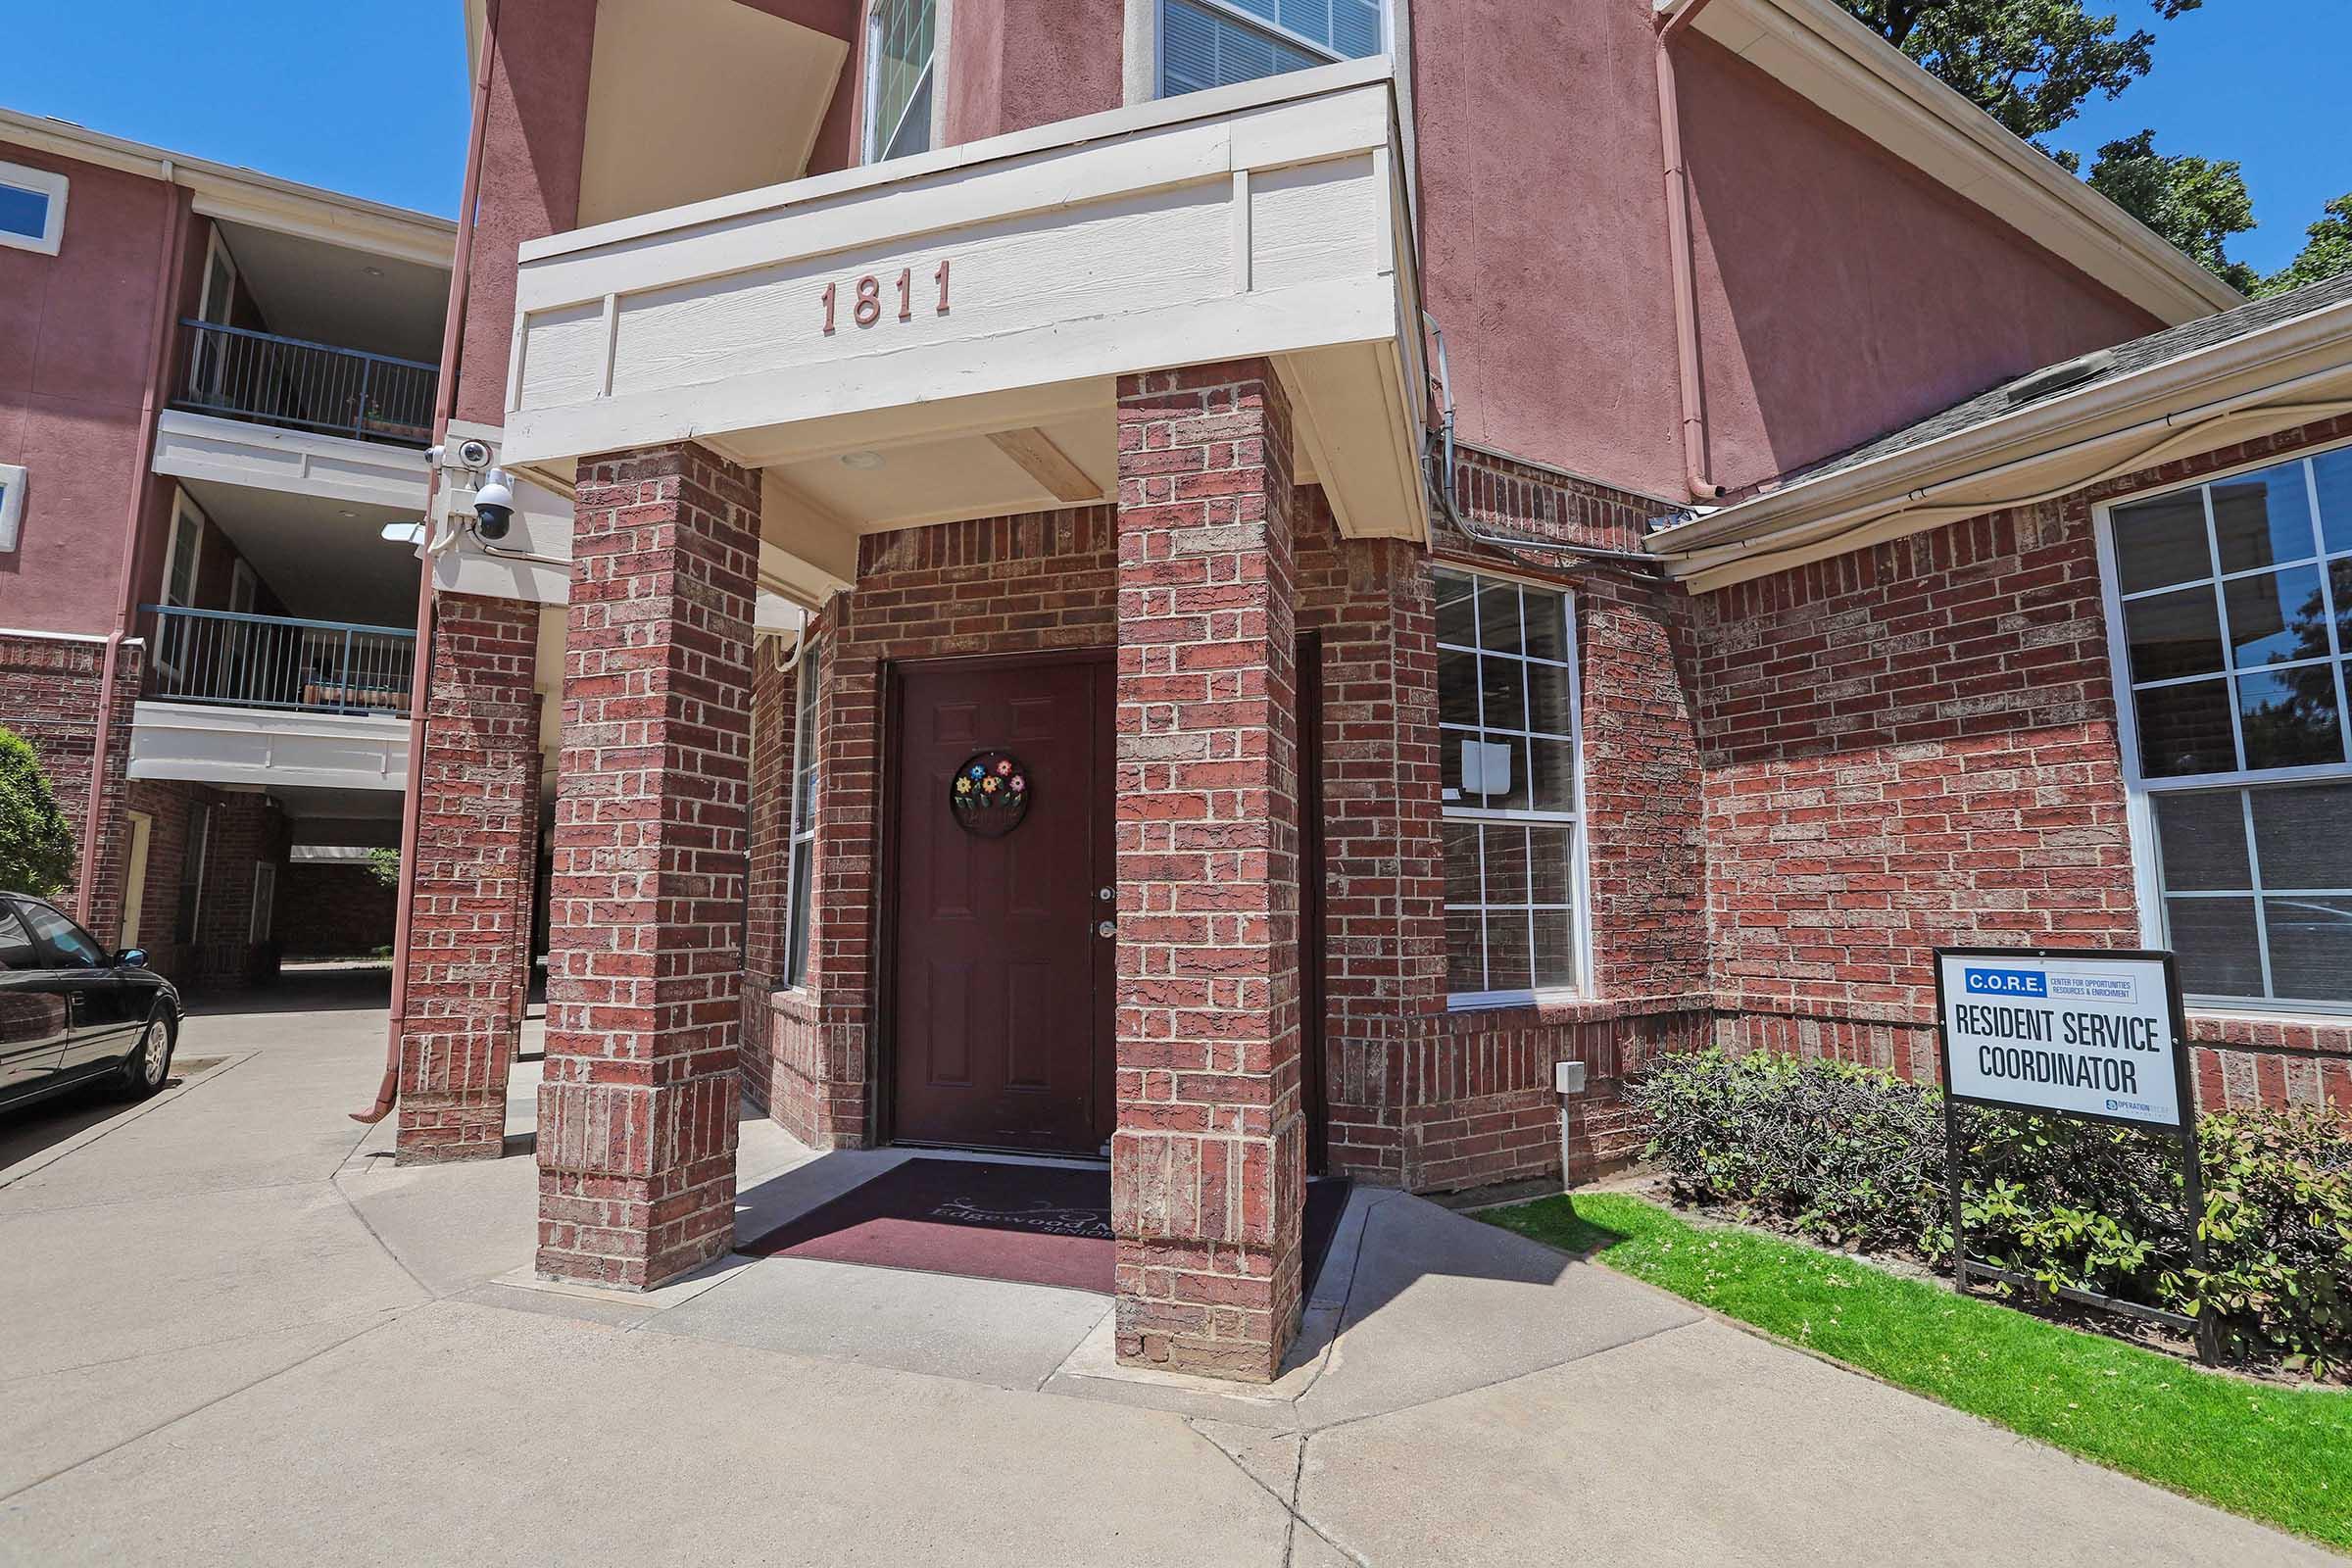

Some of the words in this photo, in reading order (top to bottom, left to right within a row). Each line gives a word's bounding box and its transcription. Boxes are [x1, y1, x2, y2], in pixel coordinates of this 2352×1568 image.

[821, 261, 950, 334] 1811
[1969, 973, 2043, 993] C.O.R.E.
[2053, 986, 2085, 996] RESOURCES
[2091, 988, 2130, 998] ENRICHMENT
[2084, 979, 2131, 989] OPPORTUNITIES
[1955, 1004, 2054, 1042] RESIDENT
[2063, 1011, 2160, 1053] SERVICE
[1979, 1045, 2137, 1095] COORDINATOR
[2118, 1101, 2150, 1111] OPERATION
[931, 1207, 1086, 1228] Edgewood
